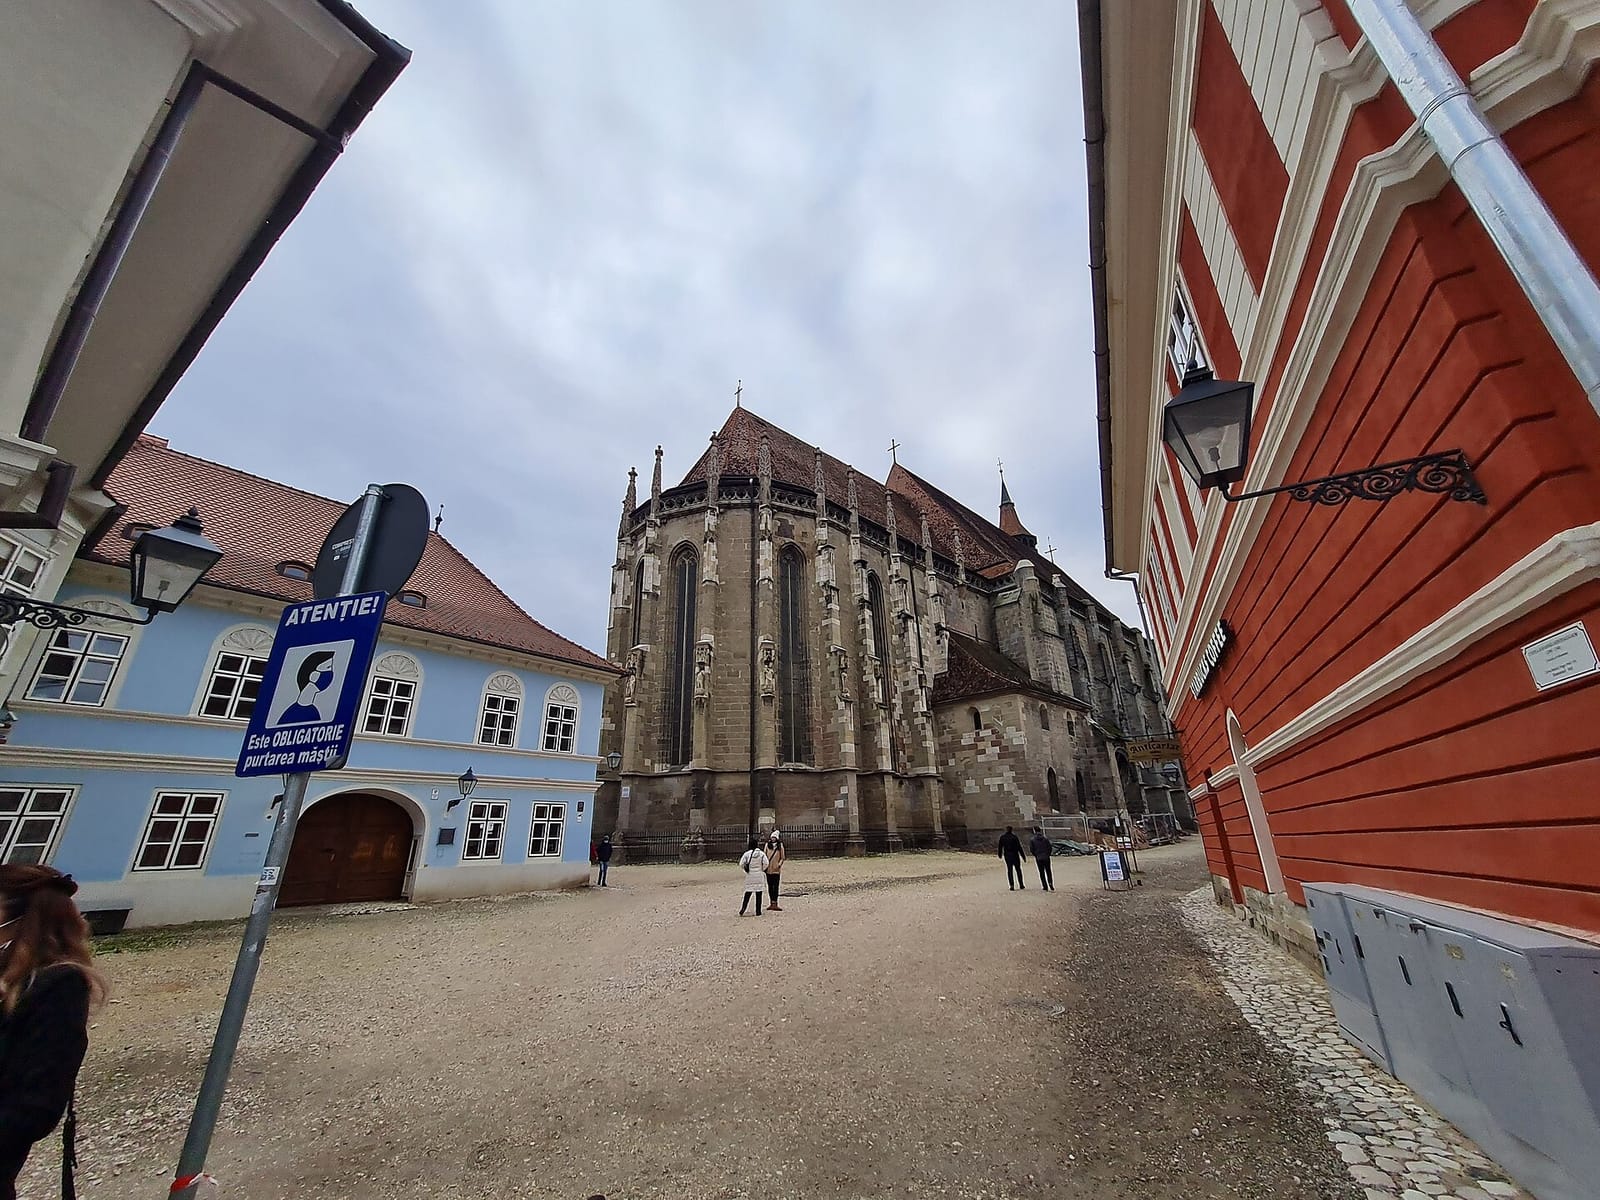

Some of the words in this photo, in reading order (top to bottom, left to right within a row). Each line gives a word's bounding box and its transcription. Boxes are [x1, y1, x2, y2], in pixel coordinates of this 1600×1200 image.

[285, 596, 380, 626] ATENȚIE!
[247, 734, 270, 750] Este
[272, 724, 345, 747] OBLIGATORIE
[242, 751, 295, 772] purtarea
